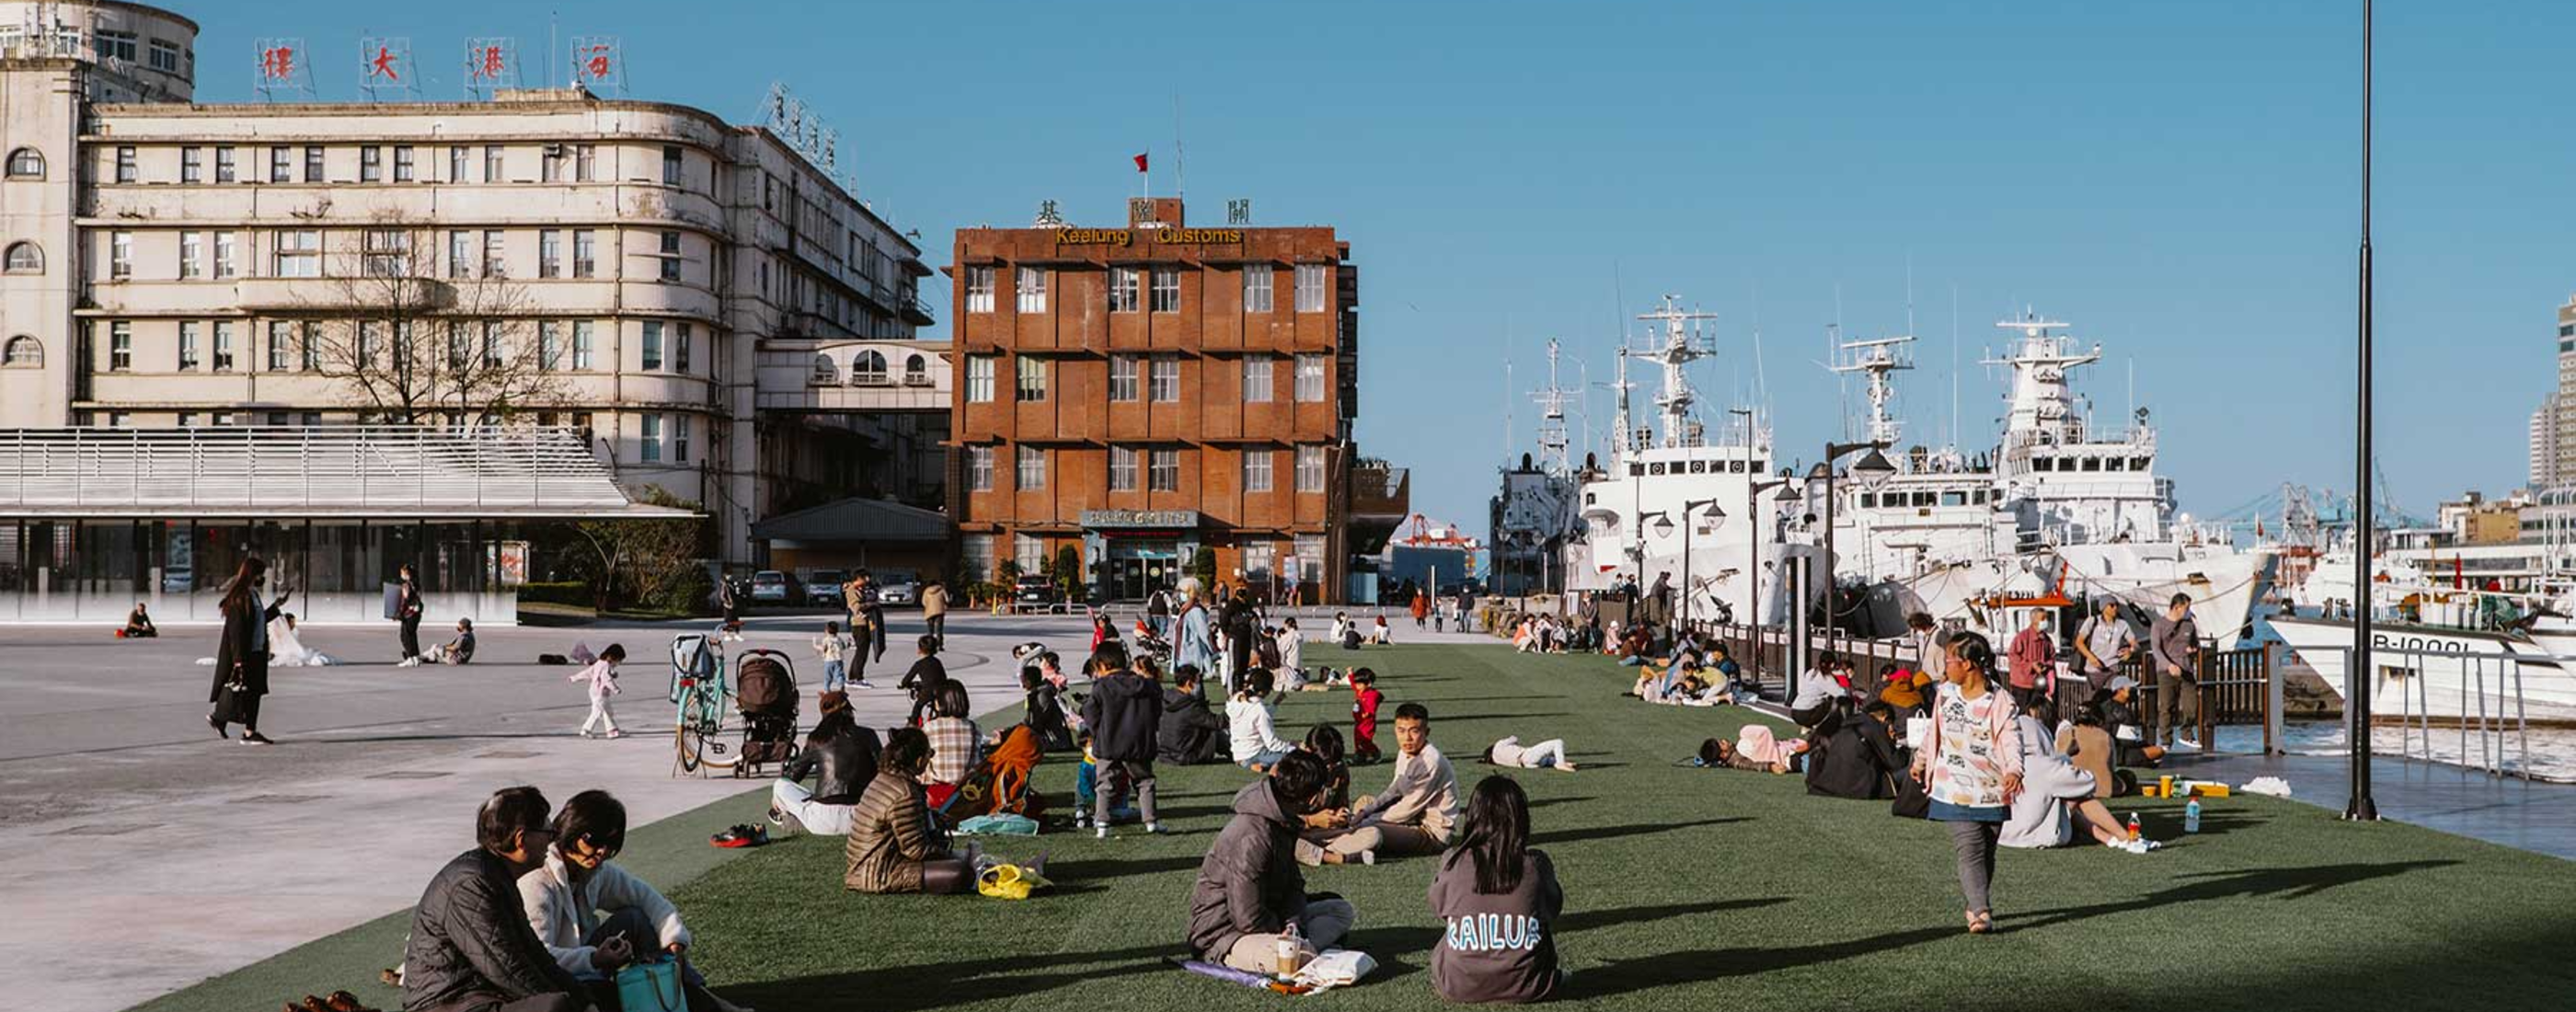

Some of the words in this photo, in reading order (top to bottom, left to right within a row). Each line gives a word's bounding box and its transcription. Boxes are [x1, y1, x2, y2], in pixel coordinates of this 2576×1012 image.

[1056, 227, 1129, 246] Keelung
[1158, 227, 1241, 243] Customs
[1447, 913, 1541, 950] KAILUA
